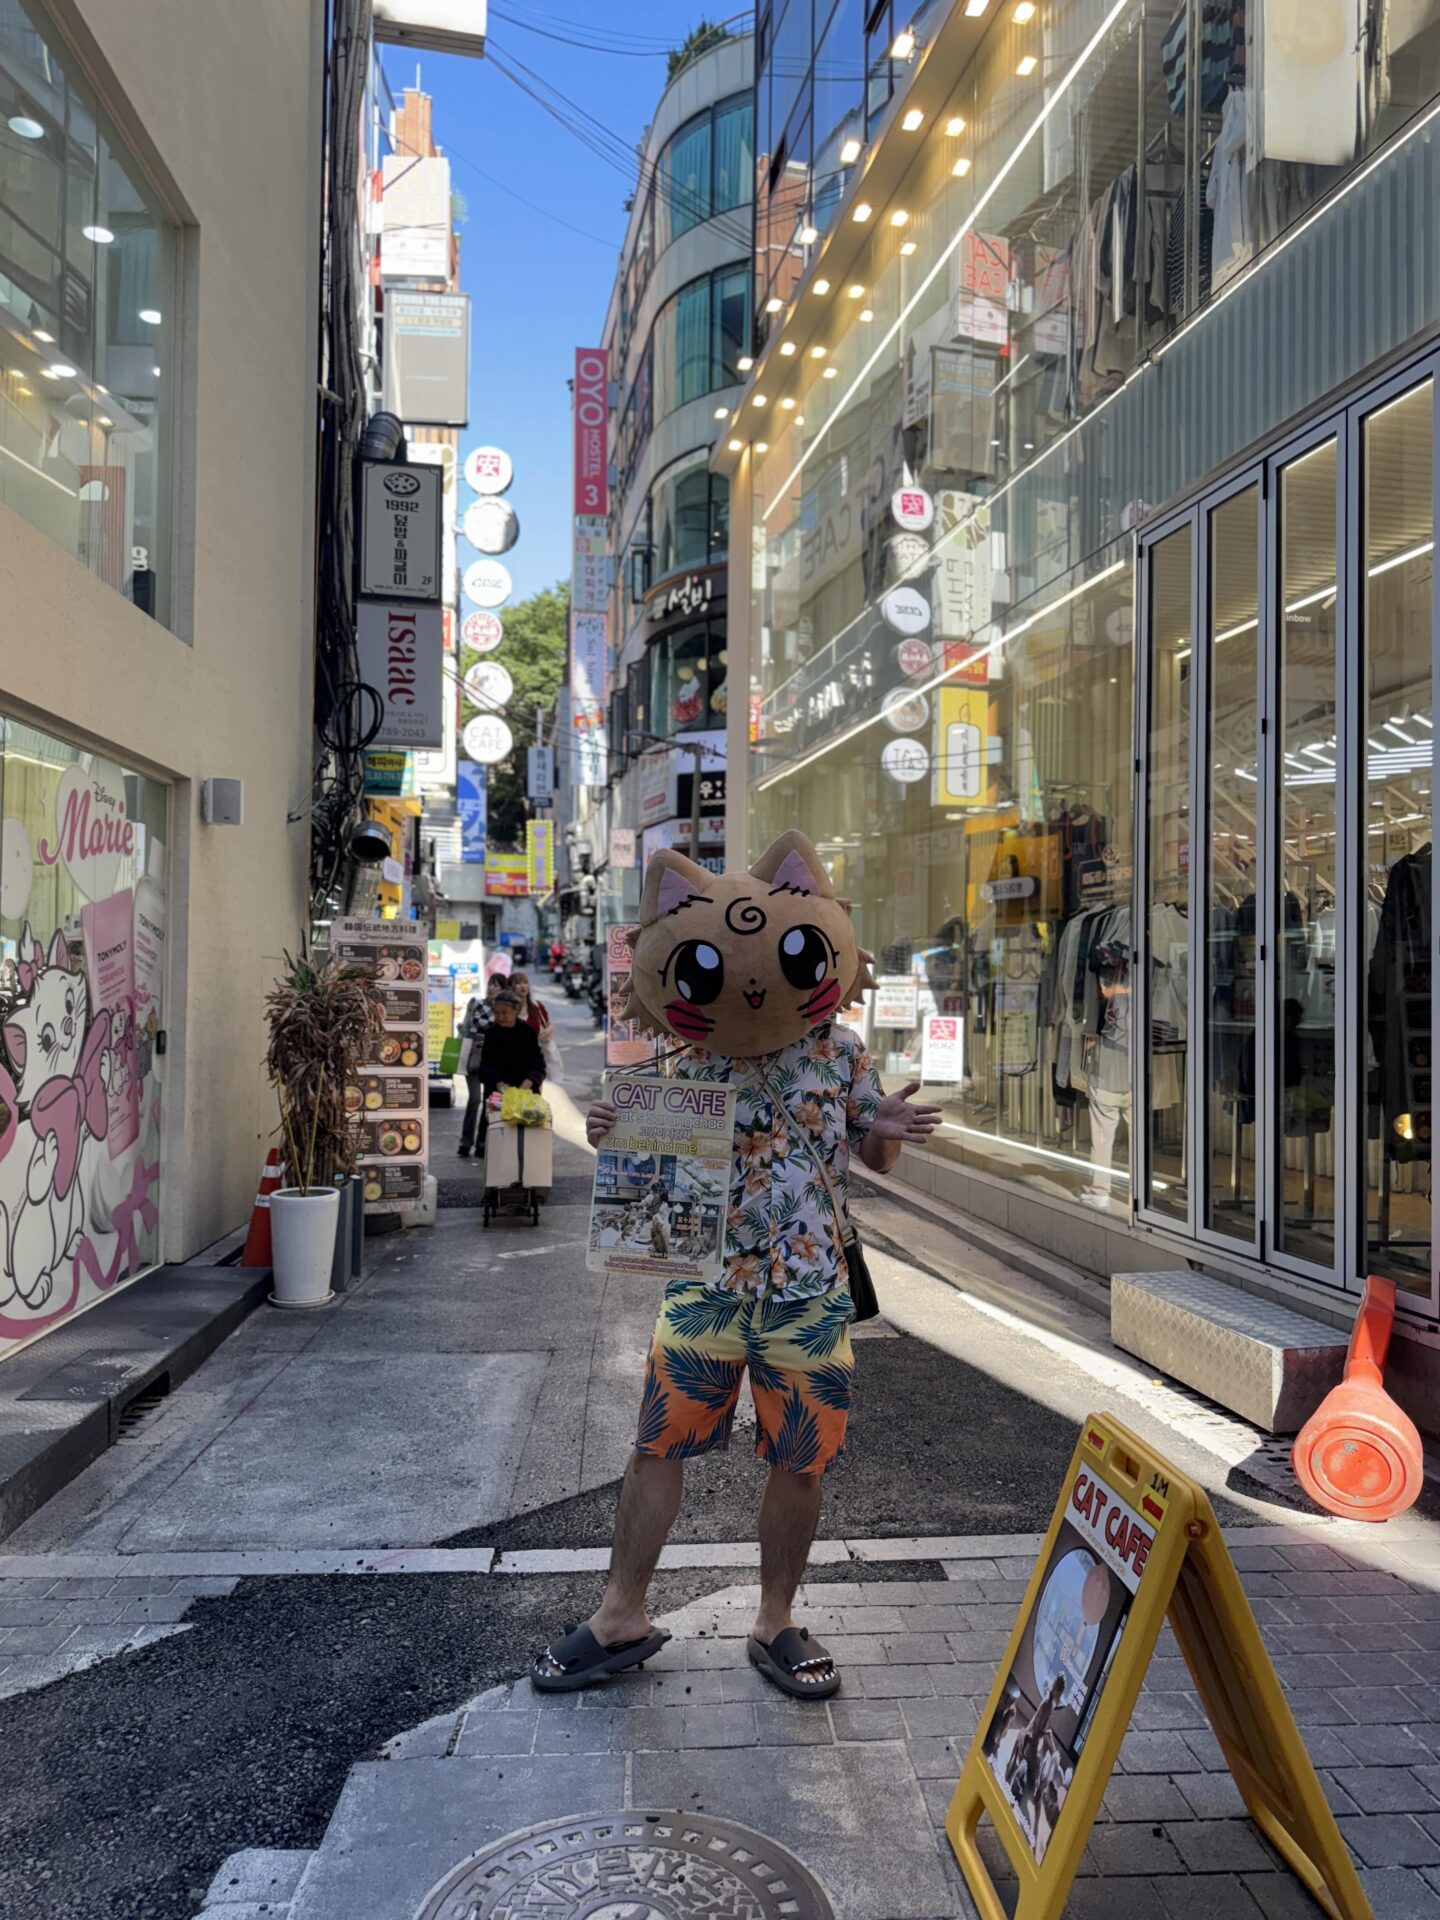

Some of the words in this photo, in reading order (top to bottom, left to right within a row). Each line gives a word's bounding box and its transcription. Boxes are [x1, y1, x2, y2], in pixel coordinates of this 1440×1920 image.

[579, 357, 604, 426] OYO
[590, 429, 601, 479] HOSTEL
[385, 499, 419, 512] 1992
[585, 484, 598, 506] 3
[421, 576, 433, 585] 2F
[668, 576, 712, 615] 설빙
[469, 738, 503, 750] CAFE
[470, 727, 502, 738] CAT
[92, 781, 117, 812] Disney
[39, 788, 135, 865] Marie
[97, 939, 127, 962] TONYMOLY
[612, 1082, 662, 1110] CAT
[663, 1087, 727, 1117] CAFE
[645, 1111, 725, 1130] Sarangchae
[607, 1133, 628, 1148] 3m
[628, 1136, 674, 1153] behind
[675, 1142, 698, 1155] me
[1072, 1474, 1108, 1529] CAT
[1105, 1506, 1154, 1578] CAFE
